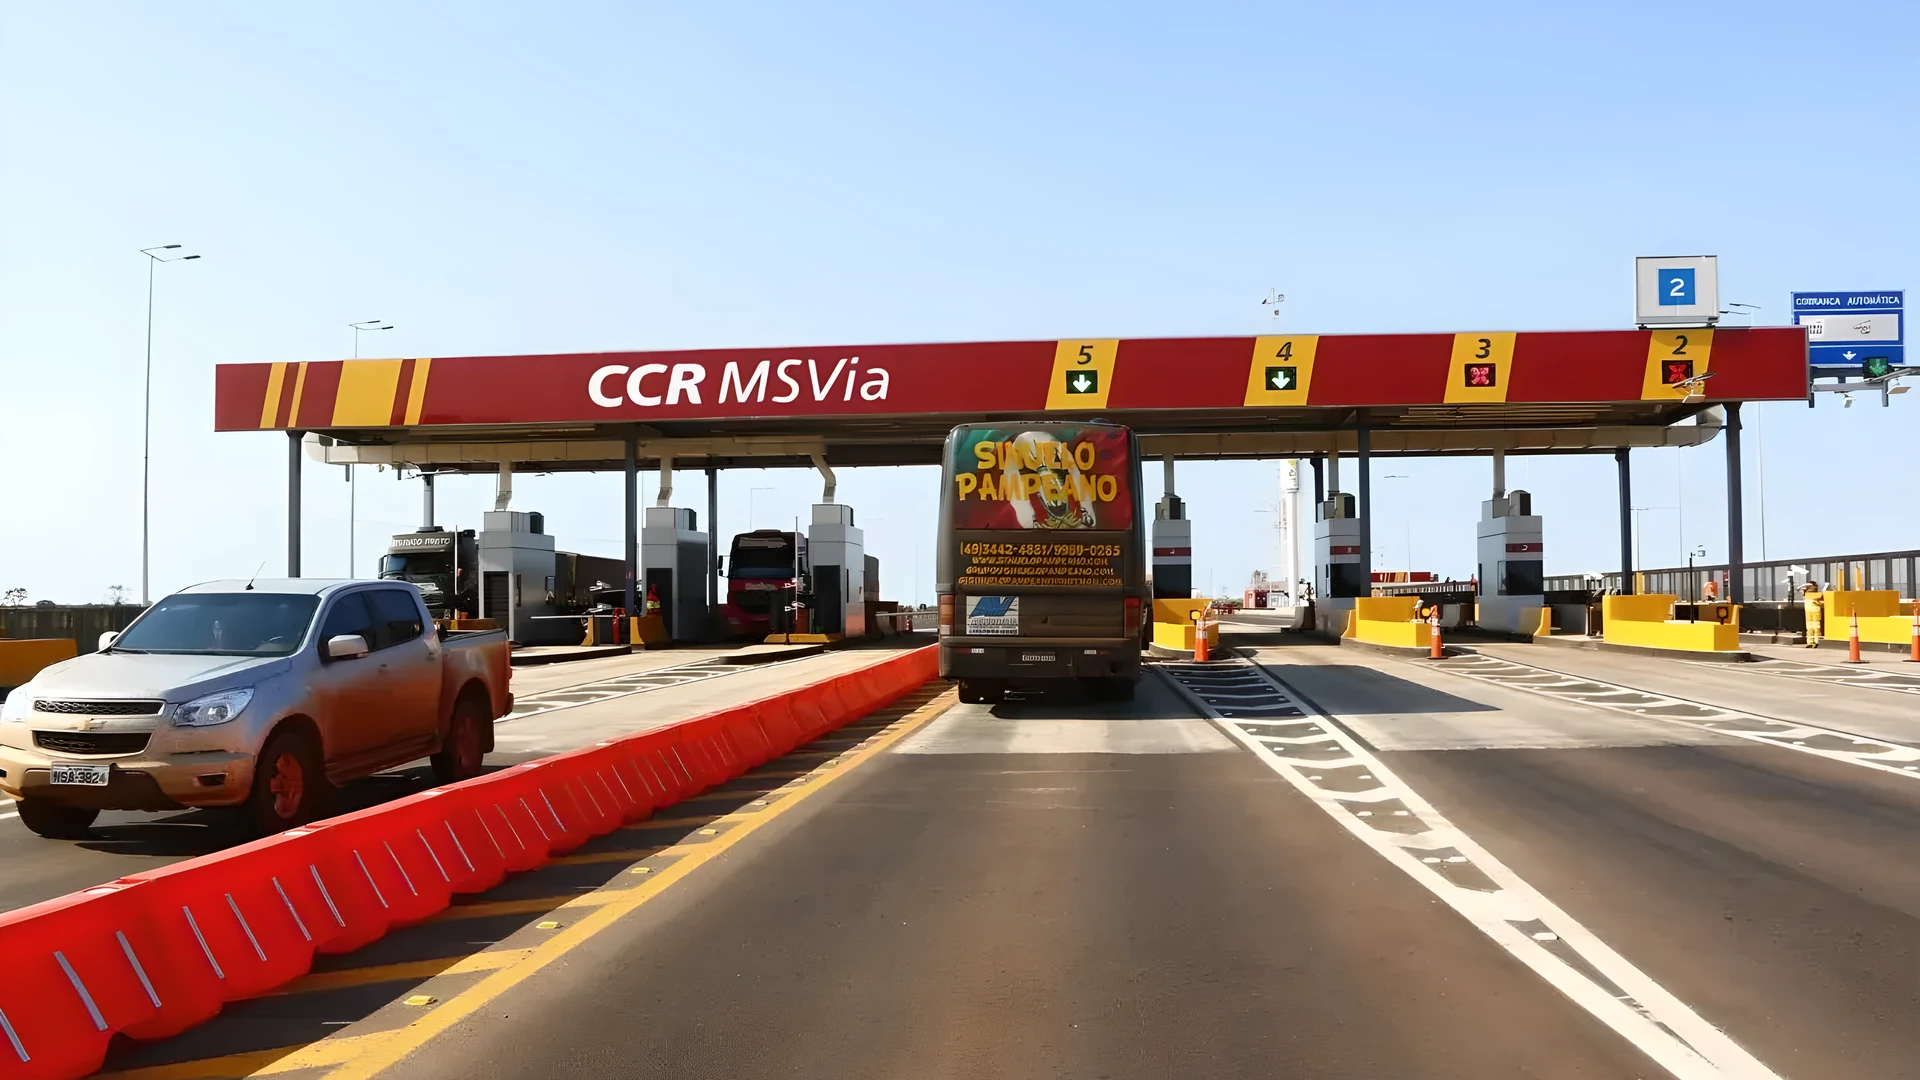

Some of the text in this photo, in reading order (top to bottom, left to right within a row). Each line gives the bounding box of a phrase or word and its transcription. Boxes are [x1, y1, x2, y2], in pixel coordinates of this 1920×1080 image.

[1669, 278, 1685, 297] 2
[1077, 345, 1094, 365] 5
[1275, 342, 1292, 361] 4
[1475, 338, 1491, 359] 3
[1672, 335, 1688, 355] 2
[588, 357, 890, 408] CCR MSVia
[955, 472, 1118, 502] PAMPEANO
